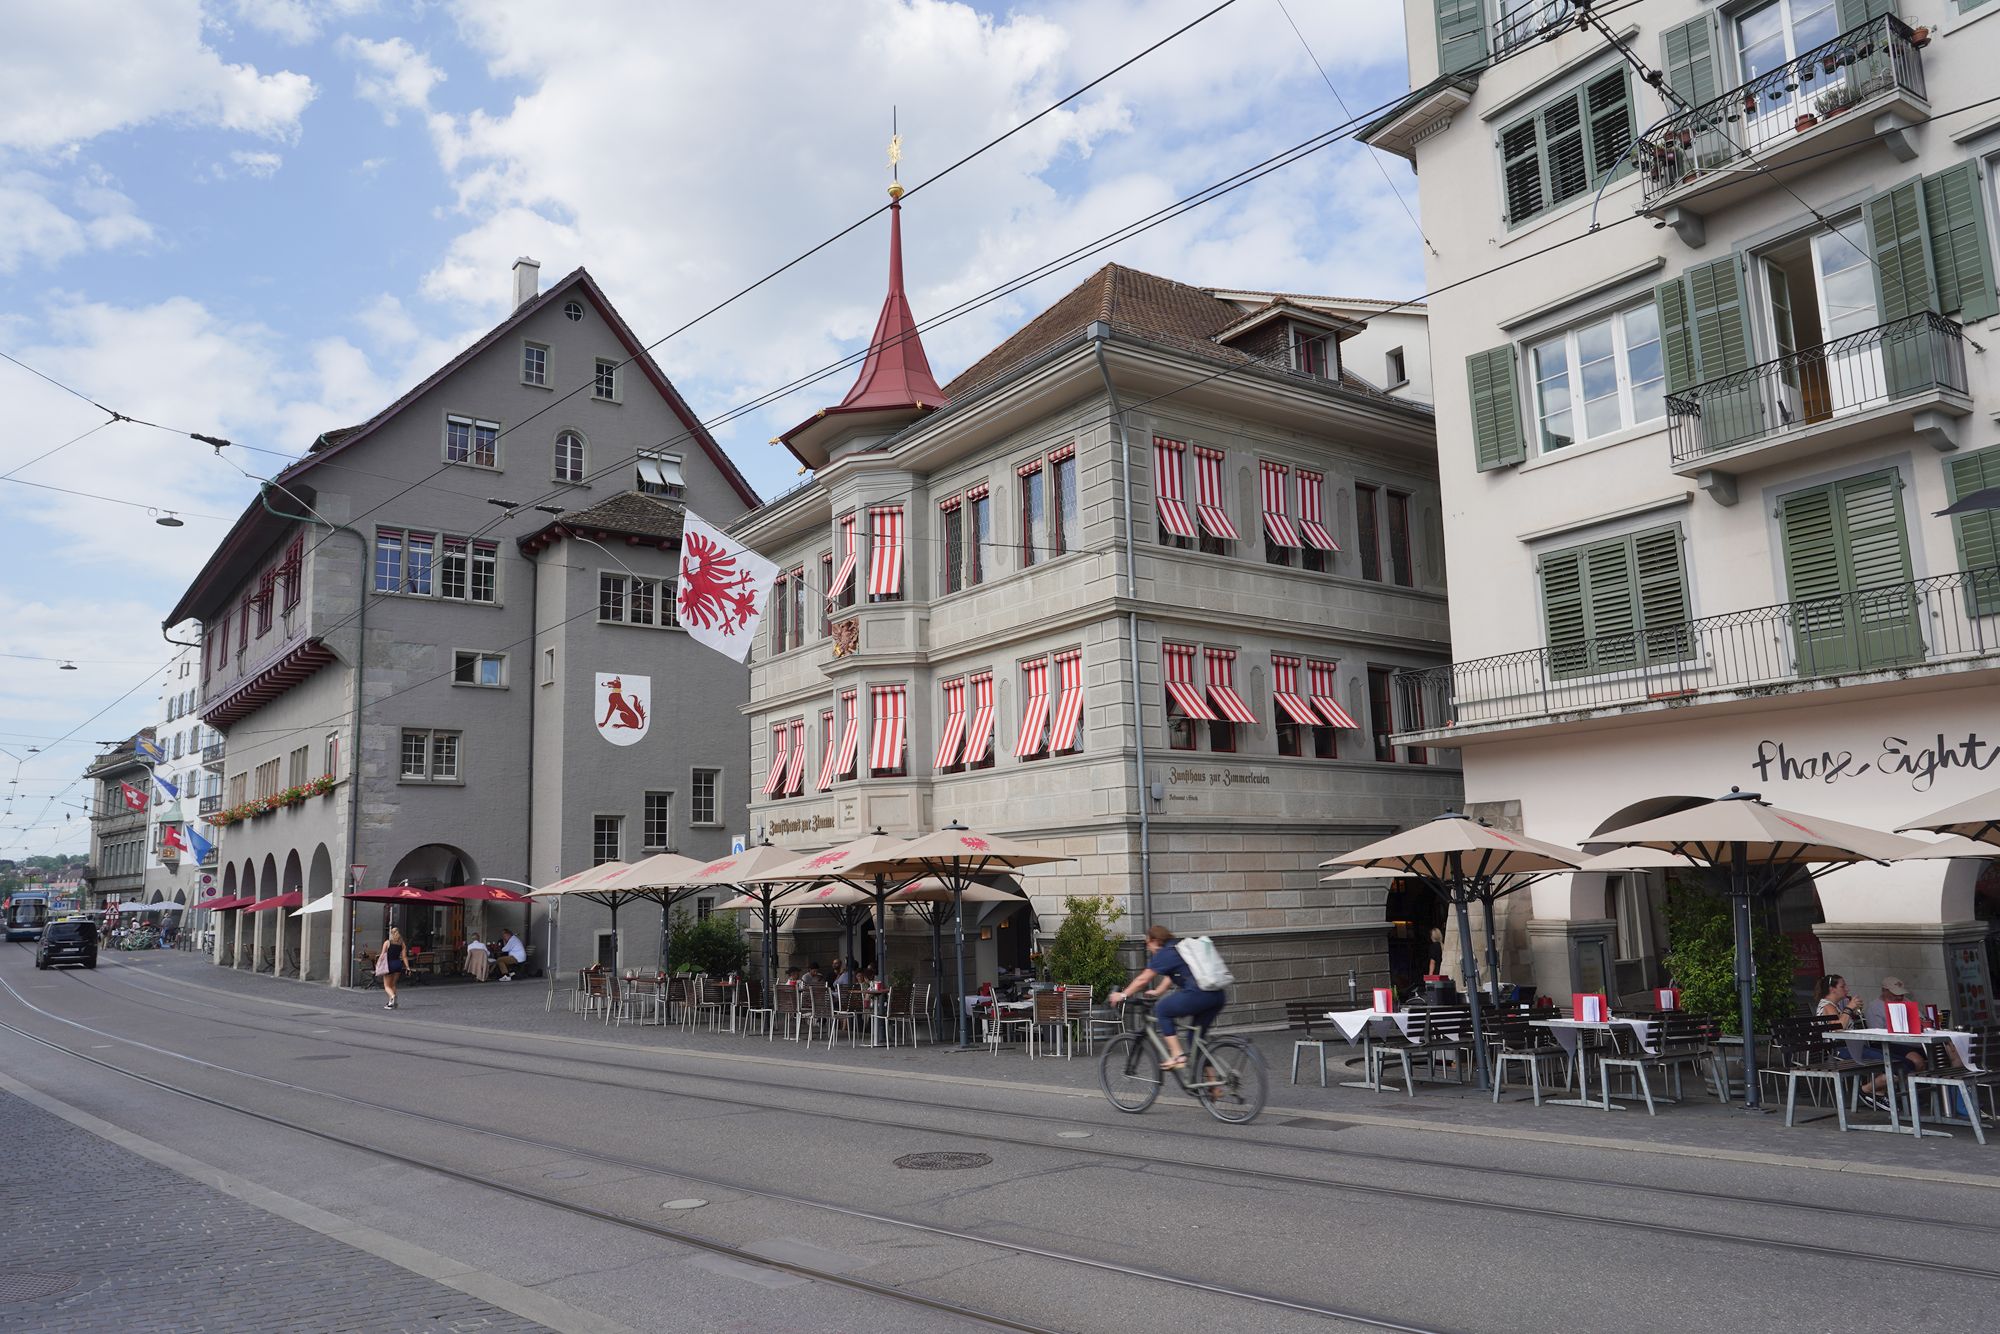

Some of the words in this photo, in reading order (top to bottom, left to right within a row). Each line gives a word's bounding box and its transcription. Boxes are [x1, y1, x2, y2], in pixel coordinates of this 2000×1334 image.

[1209, 773, 1221, 786] zur
[1752, 740, 1871, 784] Phase
[1877, 733, 2000, 792] Eight
